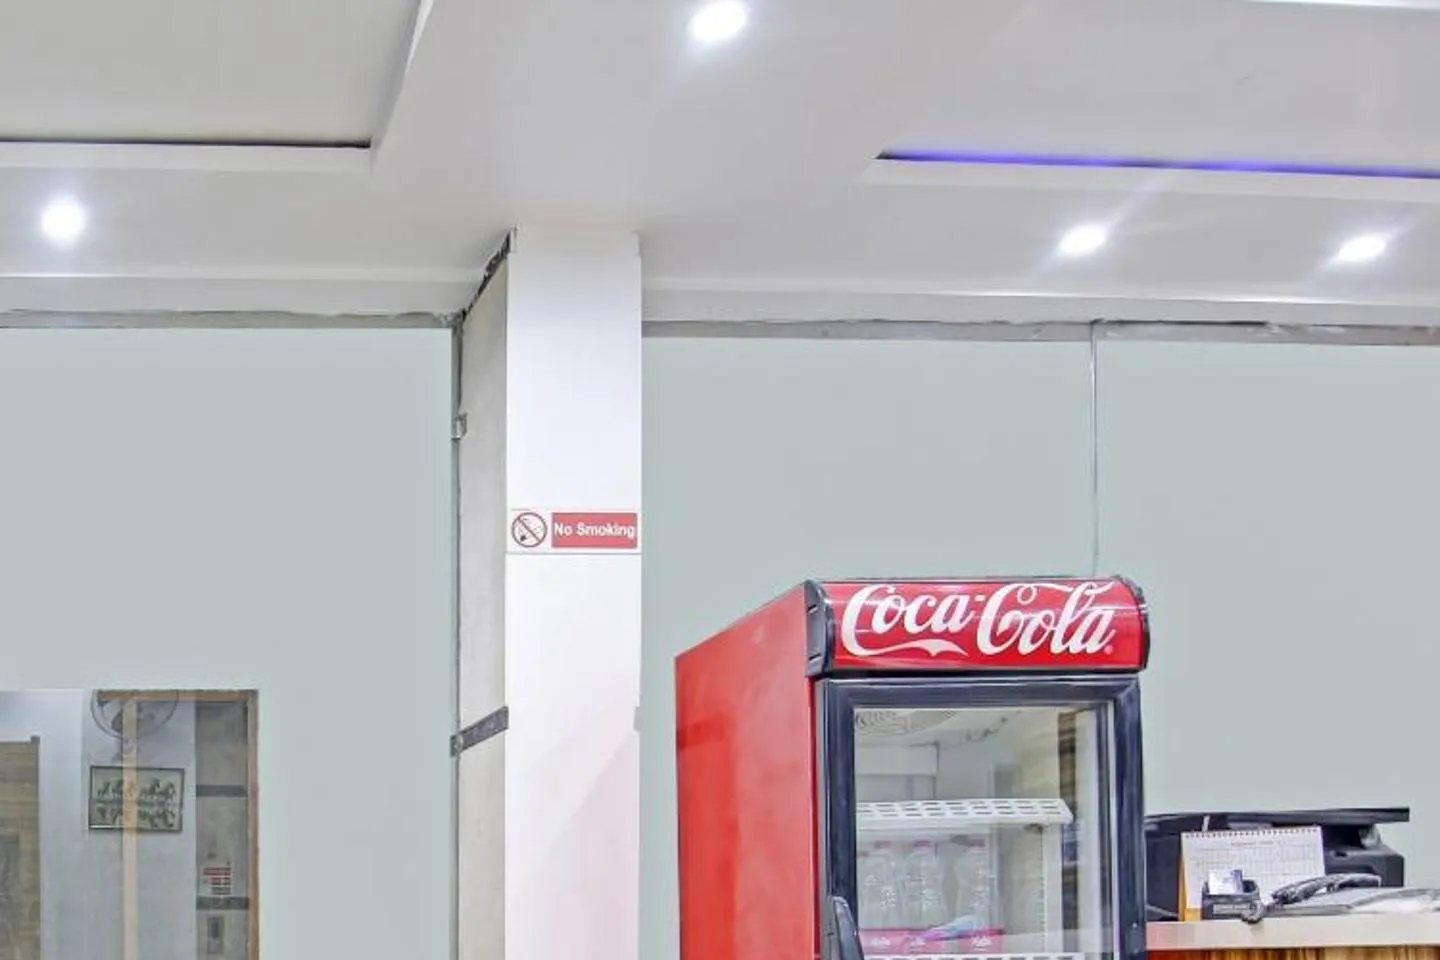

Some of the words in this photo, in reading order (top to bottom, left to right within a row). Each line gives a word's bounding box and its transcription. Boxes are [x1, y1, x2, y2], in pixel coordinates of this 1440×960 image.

[554, 522, 573, 537] No
[577, 521, 636, 541] Smoking
[840, 581, 1117, 657] Coca-Cola
